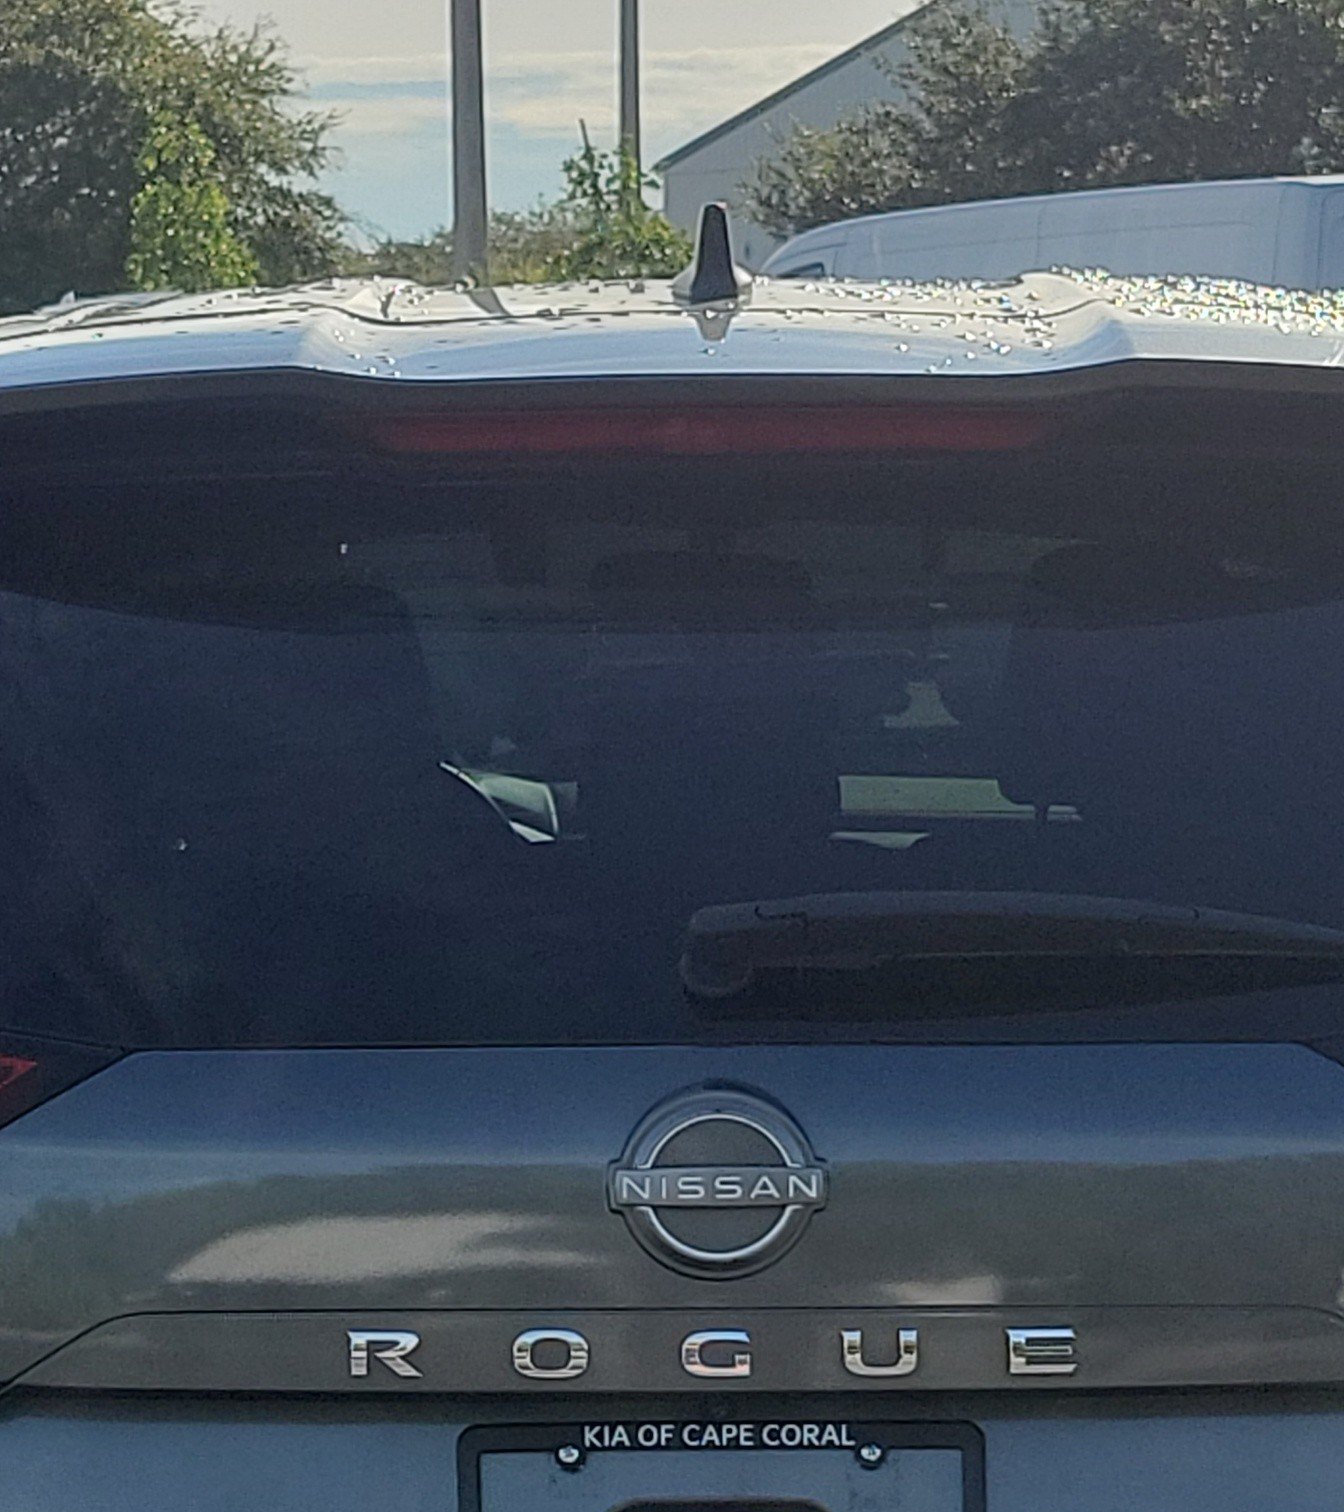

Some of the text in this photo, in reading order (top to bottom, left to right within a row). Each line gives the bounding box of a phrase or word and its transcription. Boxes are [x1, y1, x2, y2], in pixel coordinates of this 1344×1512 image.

[620, 1173, 819, 1200] NISSAN
[346, 1327, 1078, 1380] ROGUE
[583, 1423, 856, 1448] KIA OF CAPE CORAL
